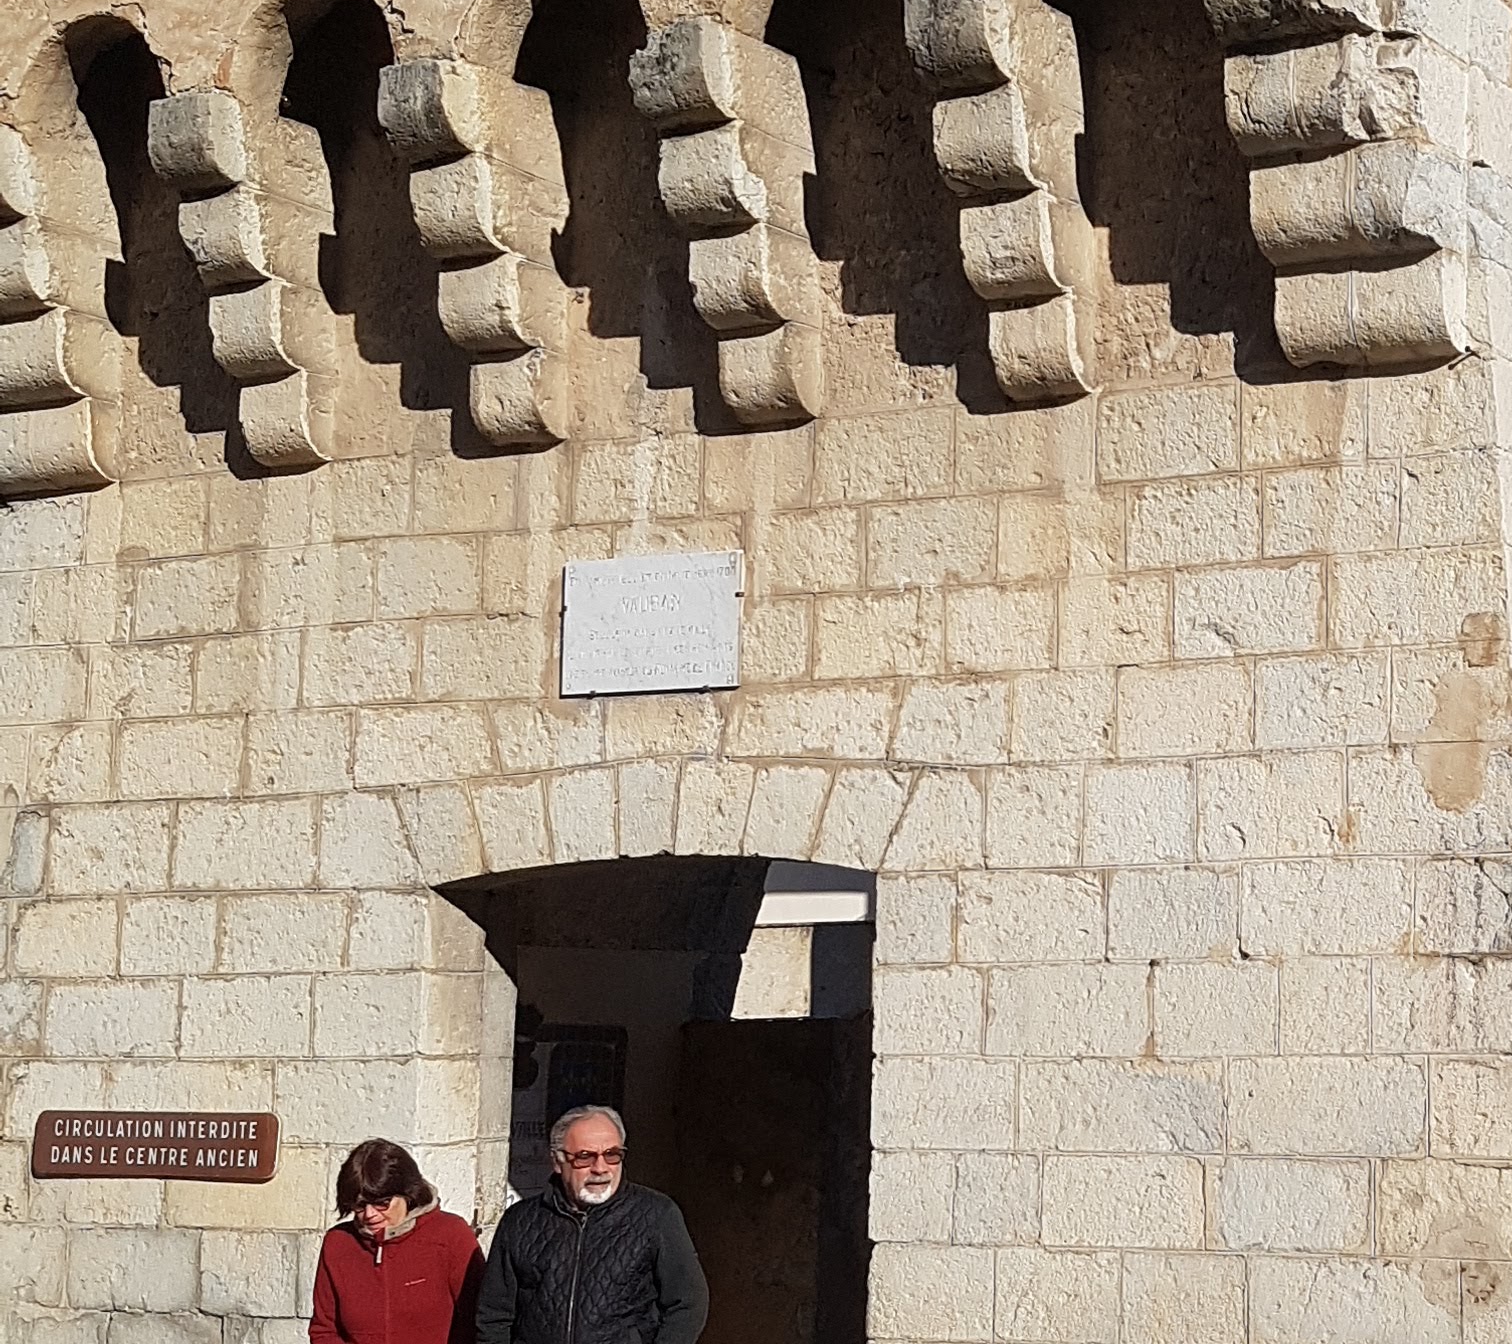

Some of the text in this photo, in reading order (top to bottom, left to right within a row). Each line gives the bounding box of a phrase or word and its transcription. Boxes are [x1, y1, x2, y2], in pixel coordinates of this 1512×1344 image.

[54, 1119, 258, 1139] CIRCULATION INTERDITE
[51, 1145, 258, 1167] DANS LE CENTRE ANCIEN
